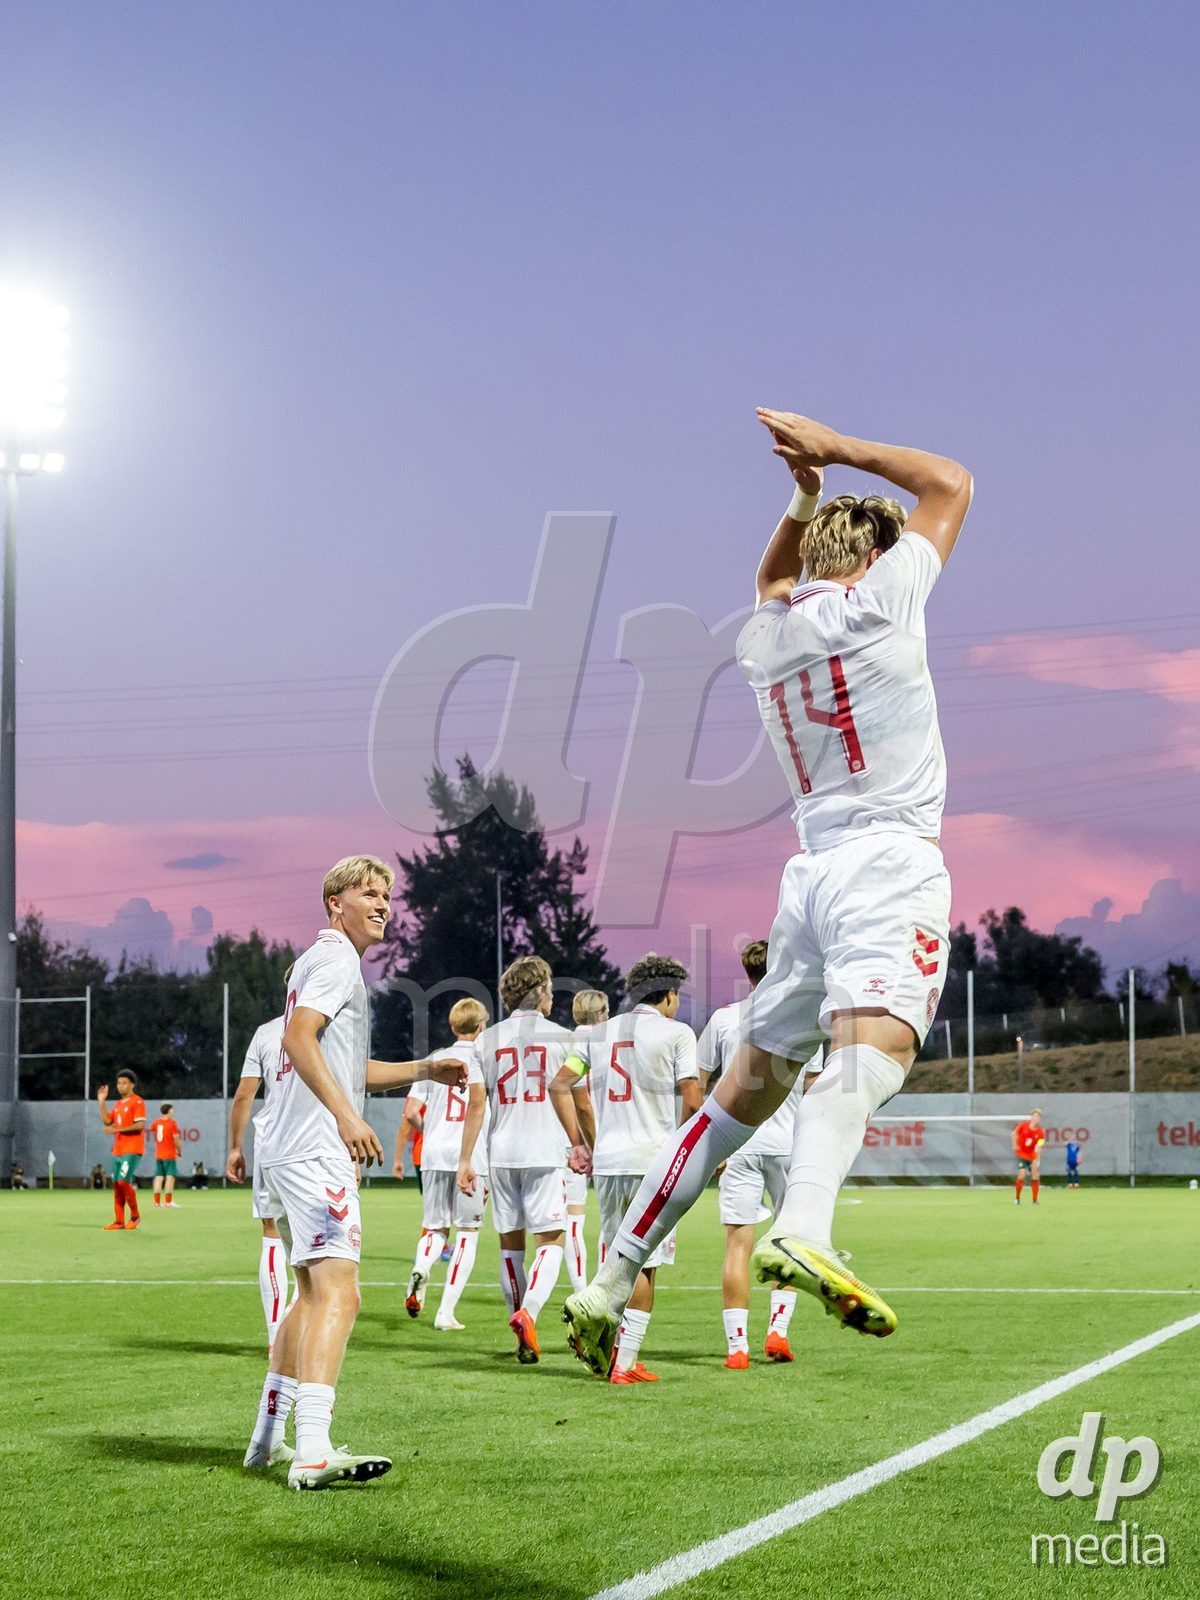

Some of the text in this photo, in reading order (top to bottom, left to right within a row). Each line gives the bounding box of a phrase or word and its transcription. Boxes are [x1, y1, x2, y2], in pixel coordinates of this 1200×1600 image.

[769, 655, 866, 795] 14
[495, 1045, 547, 1105] 23
[608, 1040, 635, 1103] 5
